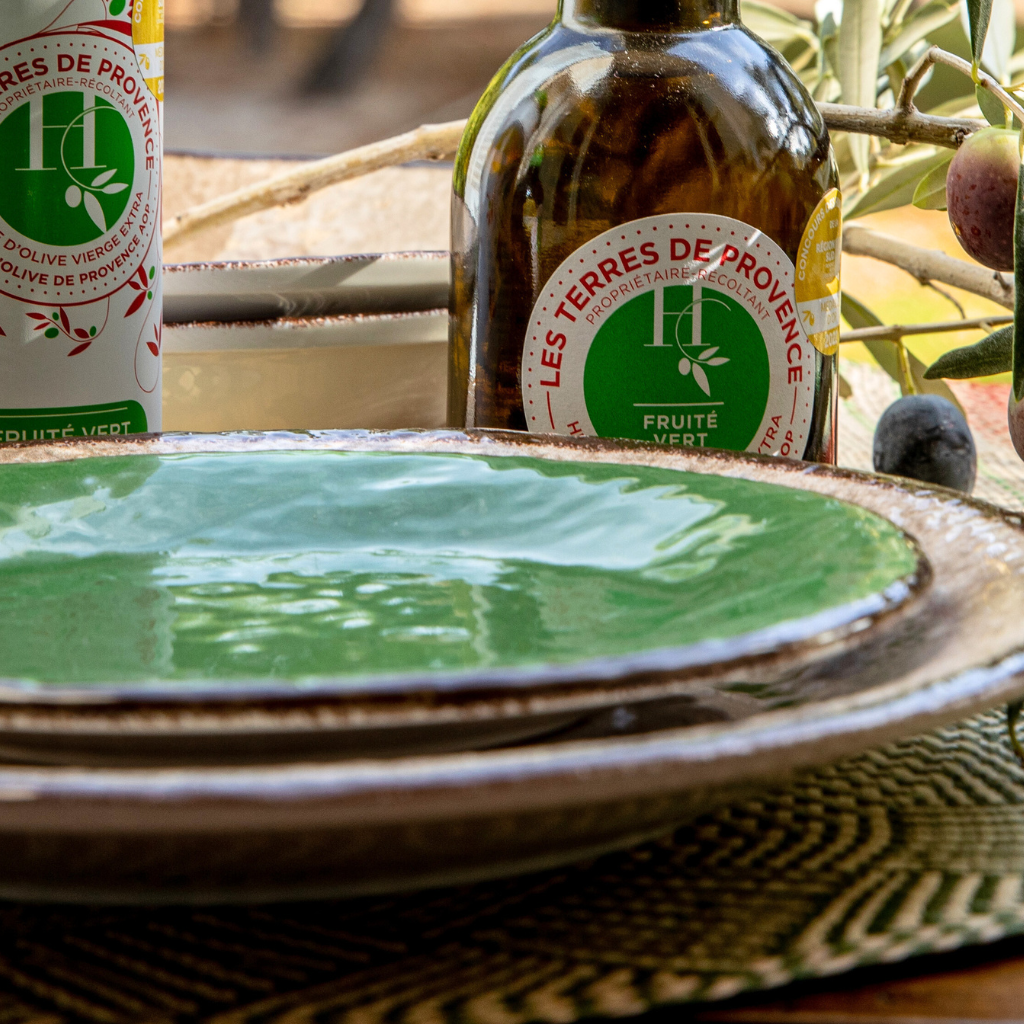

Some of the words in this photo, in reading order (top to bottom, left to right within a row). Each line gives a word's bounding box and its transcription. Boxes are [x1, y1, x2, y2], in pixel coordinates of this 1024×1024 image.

[57, 54, 92, 74] DE
[97, 58, 155, 170] PROVENCE
[3, 238, 67, 266] D'OLIVE
[71, 236, 121, 266] VIERGE
[119, 191, 144, 236] EXTRA
[53, 274, 75, 286] DE
[79, 236, 141, 285] PROVENCE
[138, 203, 151, 236] AOP
[669, 237, 713, 263] DE
[798, 207, 826, 281] CONCOURS
[553, 242, 659, 324] TERRES
[719, 244, 804, 385] PROVENCE
[540, 330, 567, 388] LES
[643, 410, 718, 430] FRUITÉ
[758, 415, 783, 454] TRA
[780, 430, 794, 456] OP
